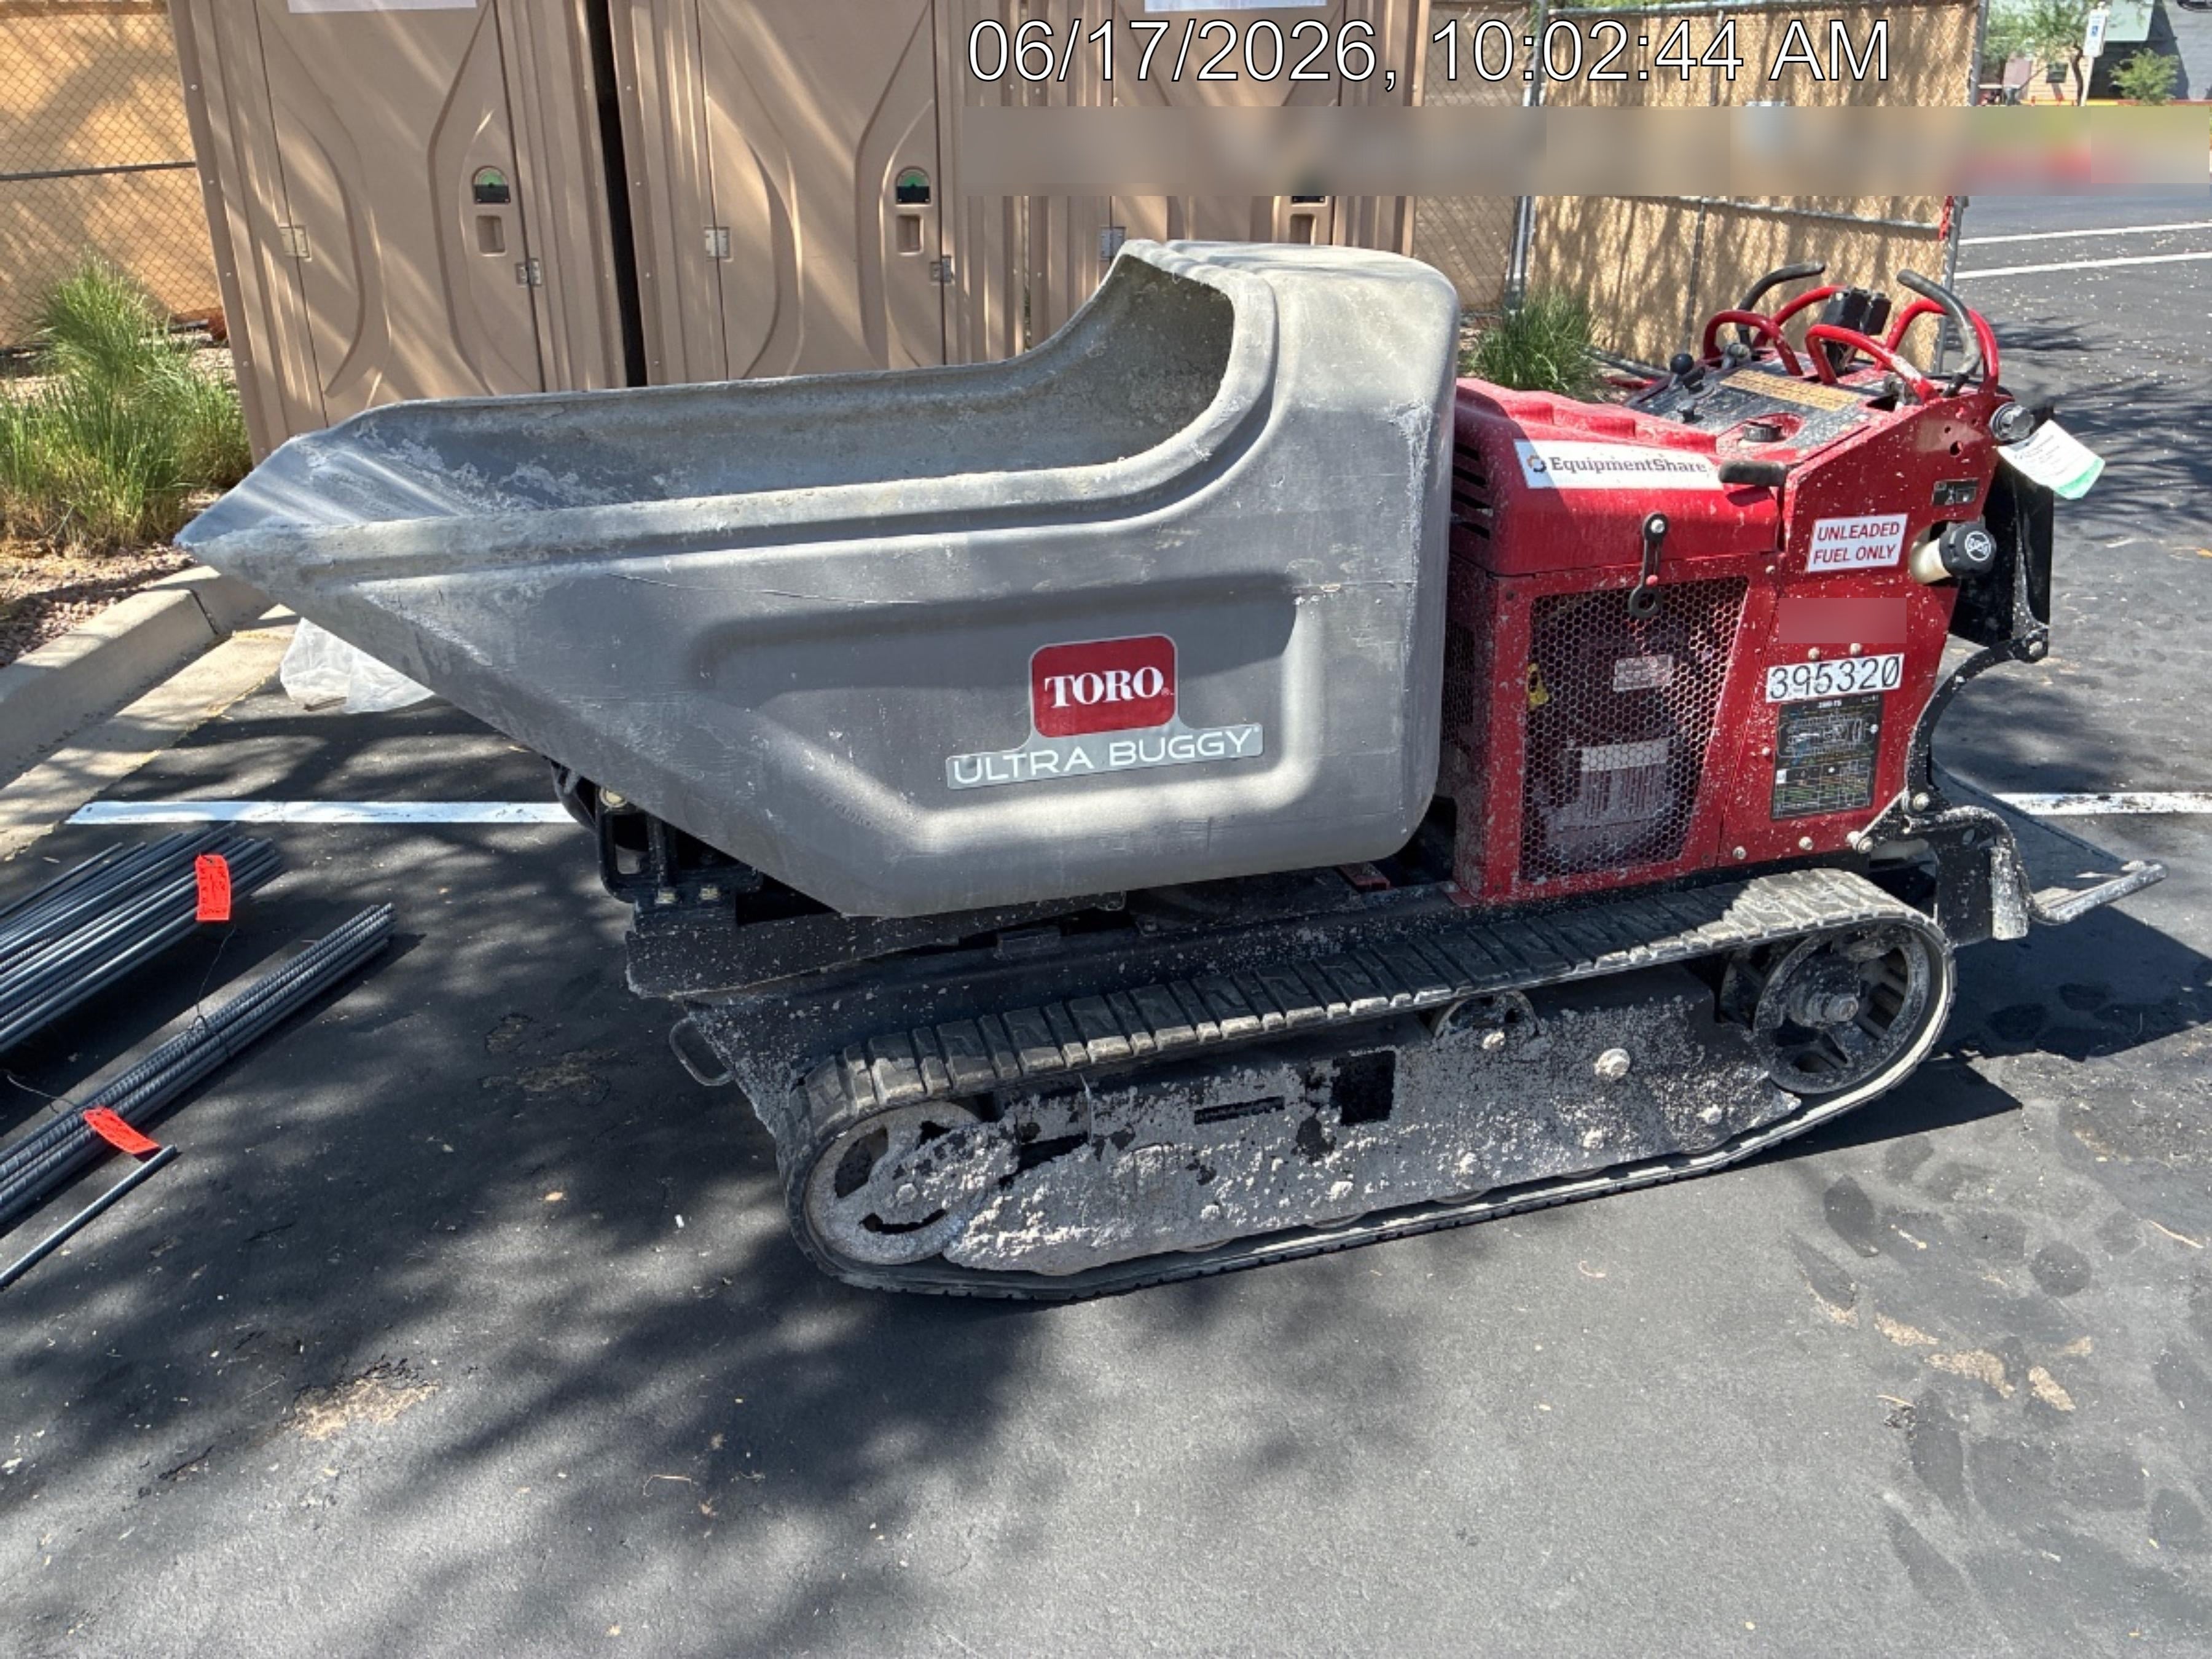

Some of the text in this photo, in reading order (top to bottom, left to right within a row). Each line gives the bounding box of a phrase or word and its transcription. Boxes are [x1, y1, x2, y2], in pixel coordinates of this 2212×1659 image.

[1550, 457, 1708, 474] EquipmentShare
[1817, 522, 1900, 542] UNLEADED
[1813, 544, 1897, 565] FUEL ONLY
[1045, 666, 1164, 708] TORO
[1770, 656, 1900, 699] 395320
[954, 728, 1252, 783] ULTRA BUGGY
